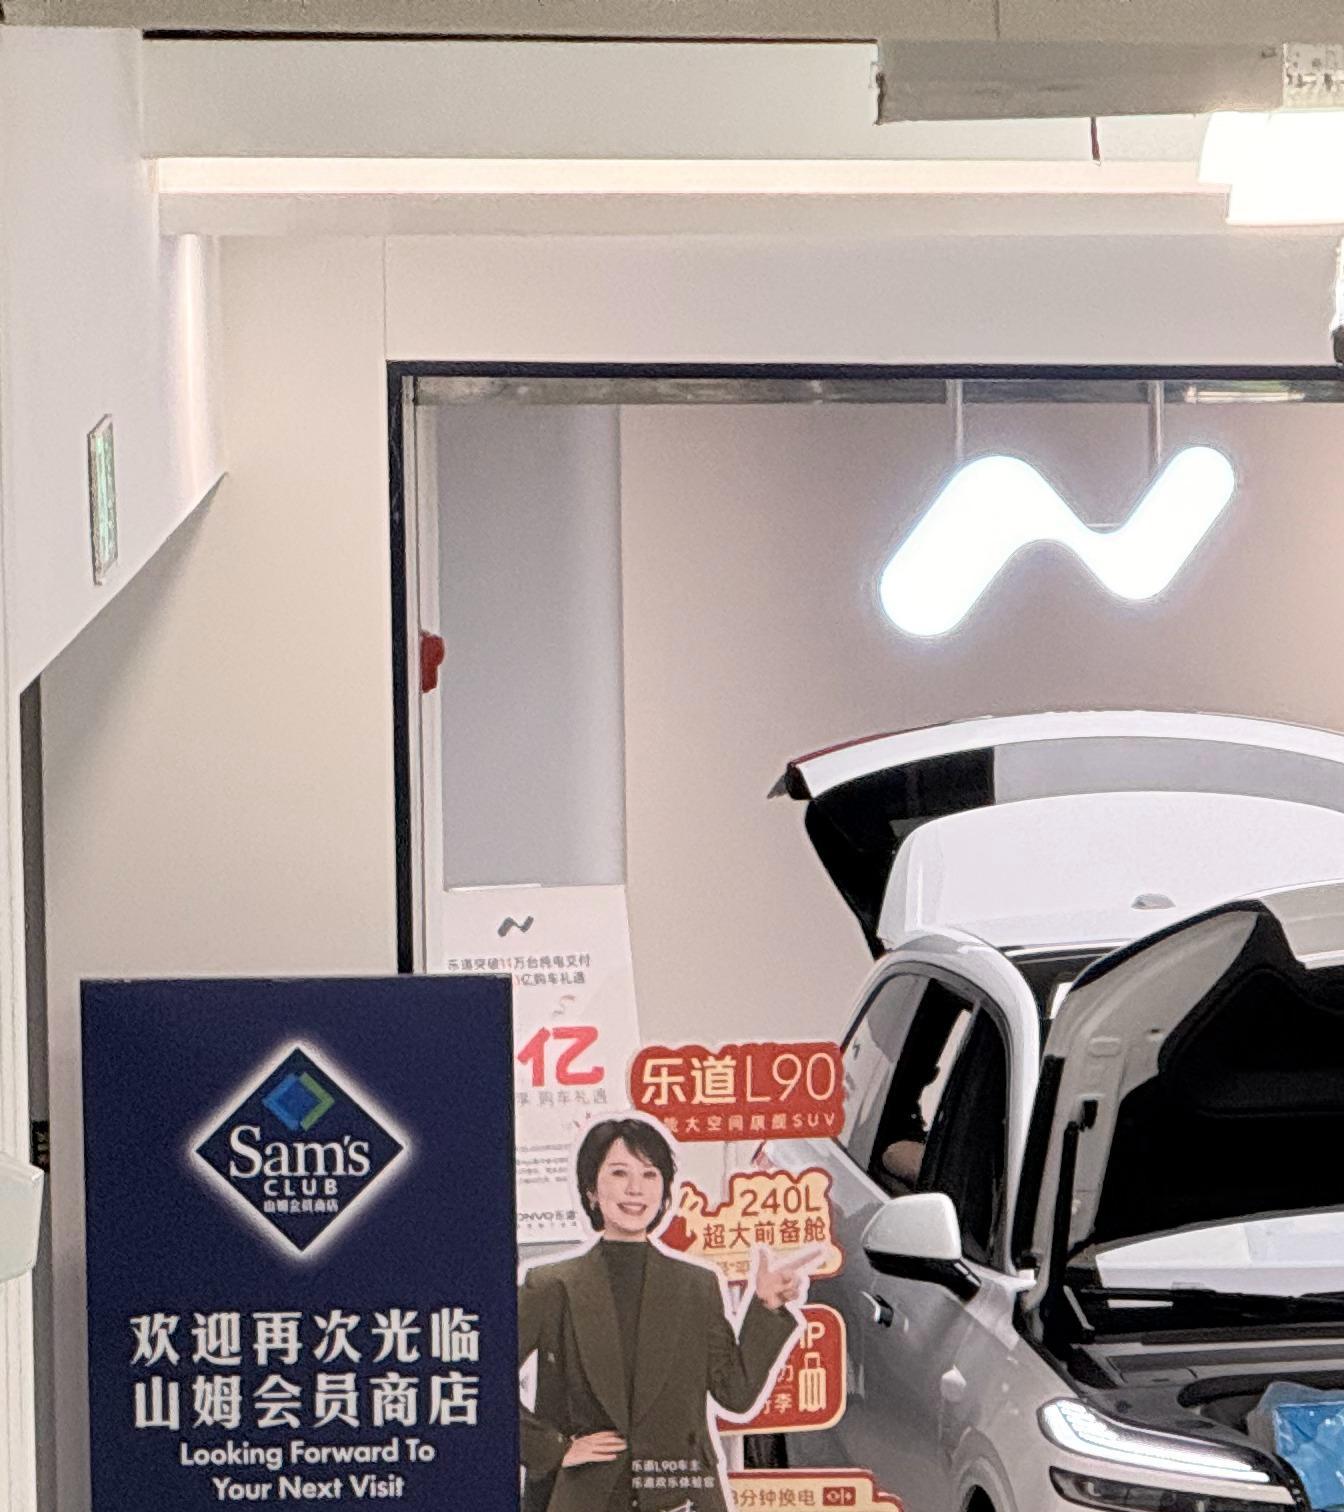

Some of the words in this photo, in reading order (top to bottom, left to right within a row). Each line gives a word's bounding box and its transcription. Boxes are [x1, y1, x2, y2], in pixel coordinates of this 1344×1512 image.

[228, 1124, 371, 1179] Sam's
[262, 1178, 339, 1197] CLUB
[740, 1184, 822, 1218] 240L
[703, 1215, 827, 1250] 超大前备舱
[129, 1307, 481, 1368] 欢迎再次光临
[132, 1371, 480, 1431] 山姆会员商店
[179, 1440, 284, 1471] Looking
[290, 1438, 399, 1465] Forward
[406, 1438, 436, 1464] To
[212, 1476, 272, 1501] Your
[278, 1476, 343, 1499] Next
[350, 1475, 405, 1498] Visit
